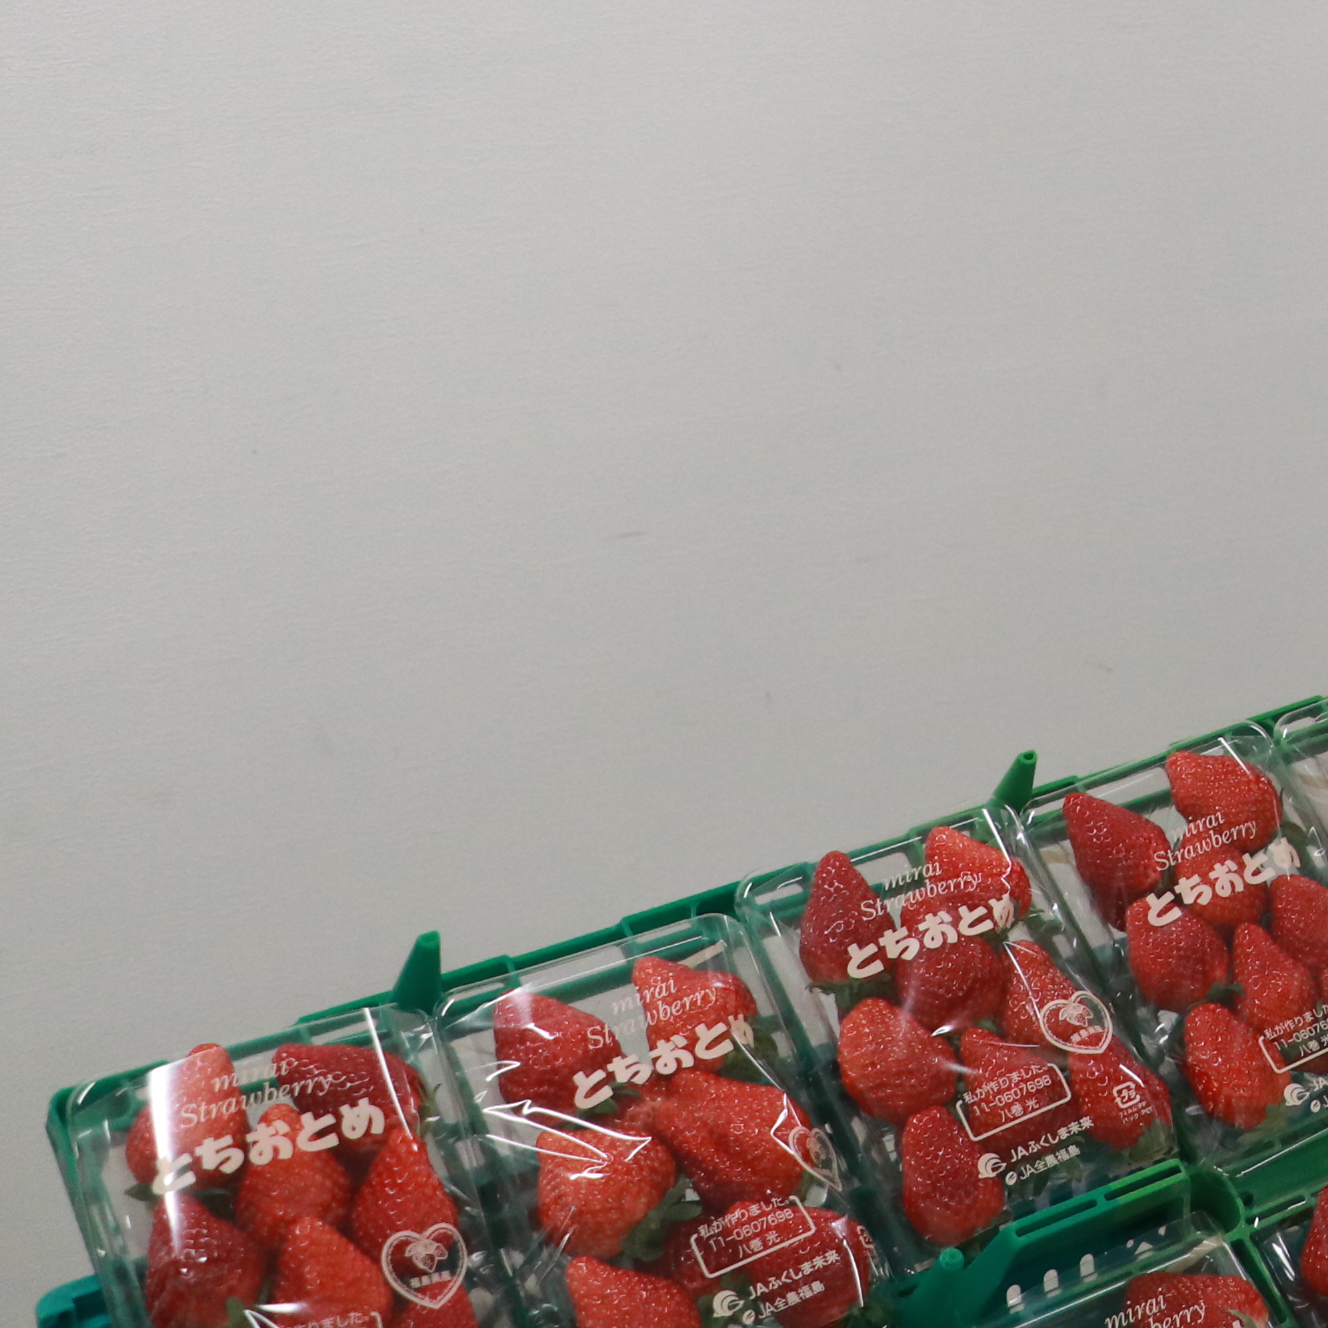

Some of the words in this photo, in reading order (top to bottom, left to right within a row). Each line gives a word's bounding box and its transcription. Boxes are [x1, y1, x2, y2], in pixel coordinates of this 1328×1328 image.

[1153, 817, 1259, 872] Strawberry
[860, 871, 981, 922] Strawberry
[1146, 836, 1302, 927] とちおとめ
[846, 893, 1016, 979] とちおとめ
[586, 985, 717, 1049] Strawberry
[572, 1013, 755, 1110] とちおとめ
[179, 1071, 334, 1129] Strawberry
[151, 1097, 386, 1196] とちおとめ
[1010, 1115, 1095, 1163] JAふくしま未来
[747, 1249, 841, 1300] JAふくしま未来
